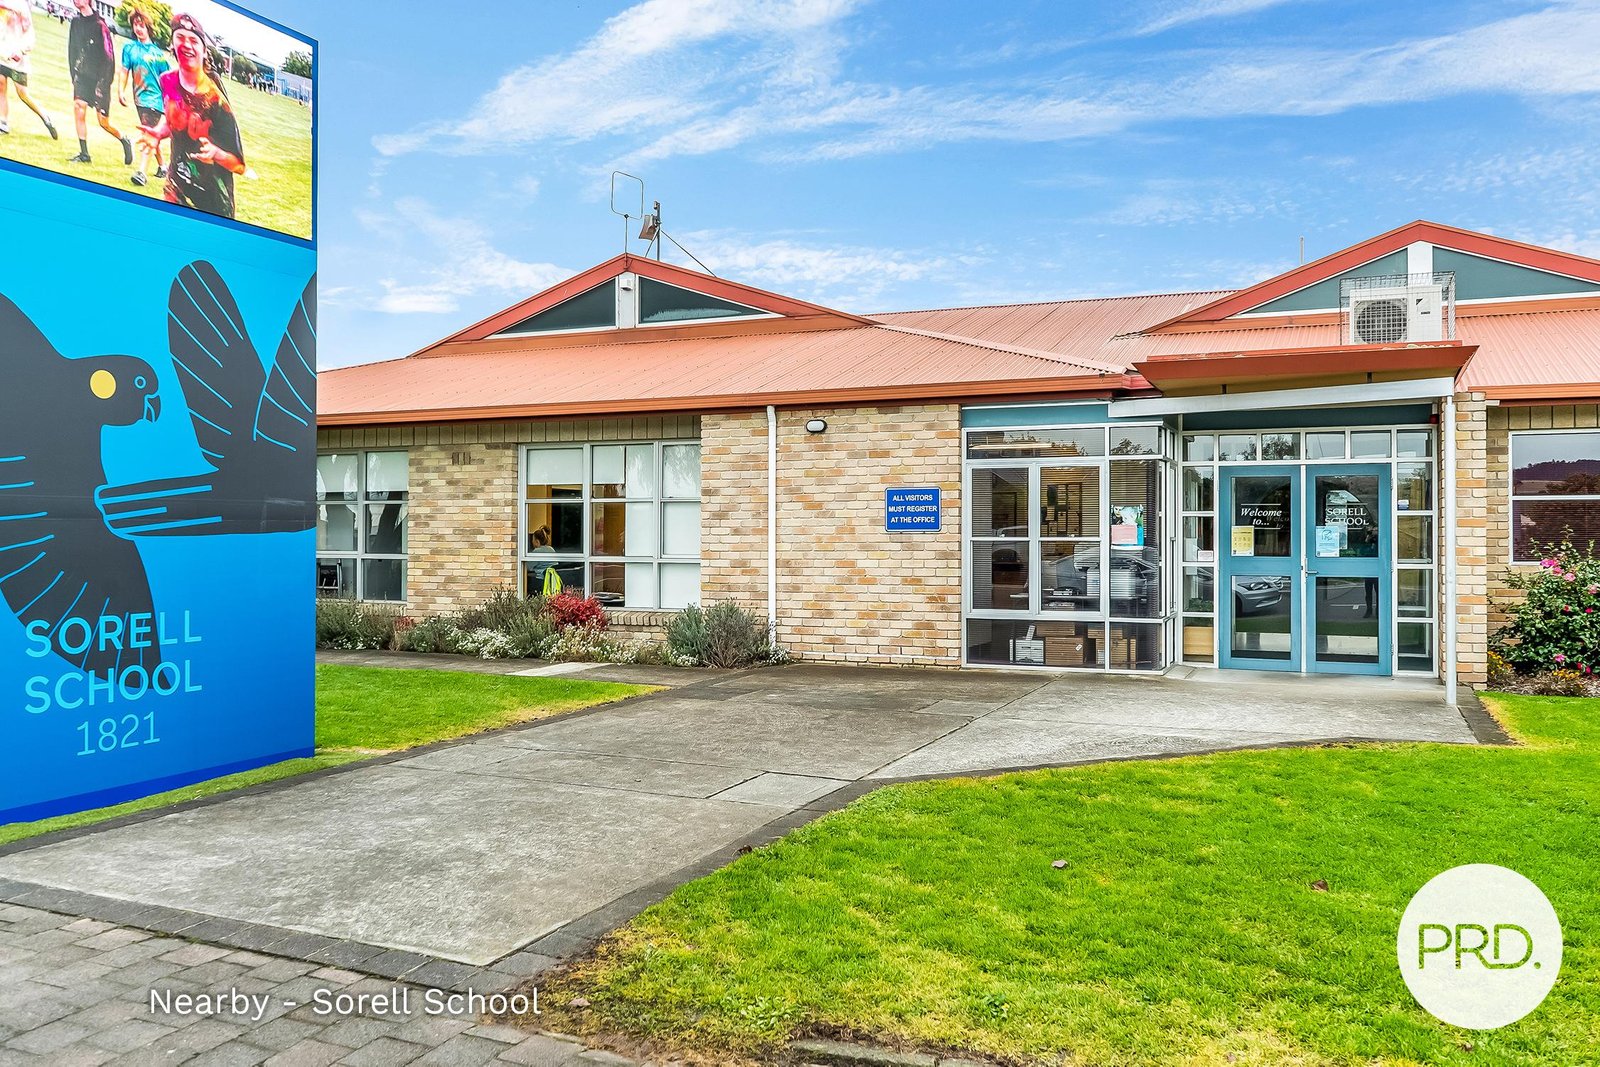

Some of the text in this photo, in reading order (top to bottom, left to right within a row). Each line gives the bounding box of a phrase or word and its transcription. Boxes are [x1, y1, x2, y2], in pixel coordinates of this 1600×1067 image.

[1240, 508, 1282, 516] Welcome
[1324, 517, 1370, 526] SCHOOL
[1326, 507, 1367, 516] SORELL
[25, 610, 202, 658] SORELL
[24, 659, 202, 714] SCHOOL
[76, 711, 161, 756] 1821
